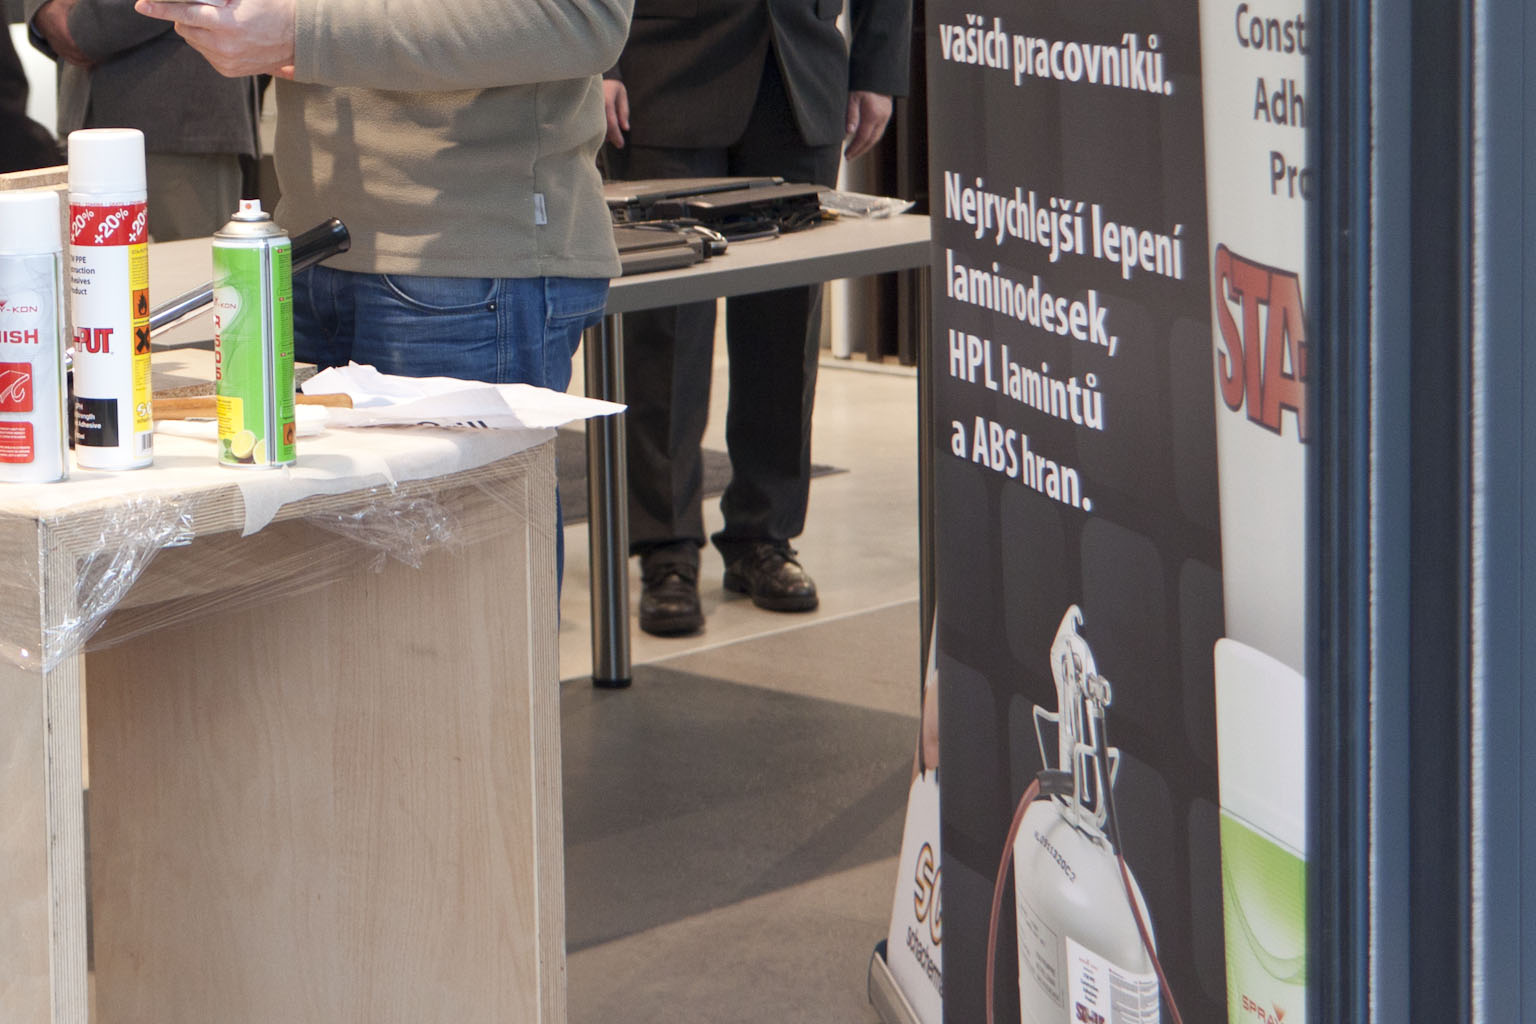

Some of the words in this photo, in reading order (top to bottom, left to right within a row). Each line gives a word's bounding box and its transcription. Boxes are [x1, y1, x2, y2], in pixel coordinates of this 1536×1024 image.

[939, 13, 1009, 71] vašich
[1013, 33, 1173, 96] pracovníků.
[1253, 77, 1306, 128] Adh
[94, 207, 129, 244] +20%
[944, 171, 1085, 263] Nejrychlejší
[1090, 203, 1185, 280] lepení
[945, 249, 1119, 358] laminodesek,
[948, 328, 998, 392] HPL
[1001, 345, 1104, 430] lamintů
[951, 419, 966, 458] a
[972, 416, 1019, 479] ABS
[1022, 433, 1093, 512] hran.
